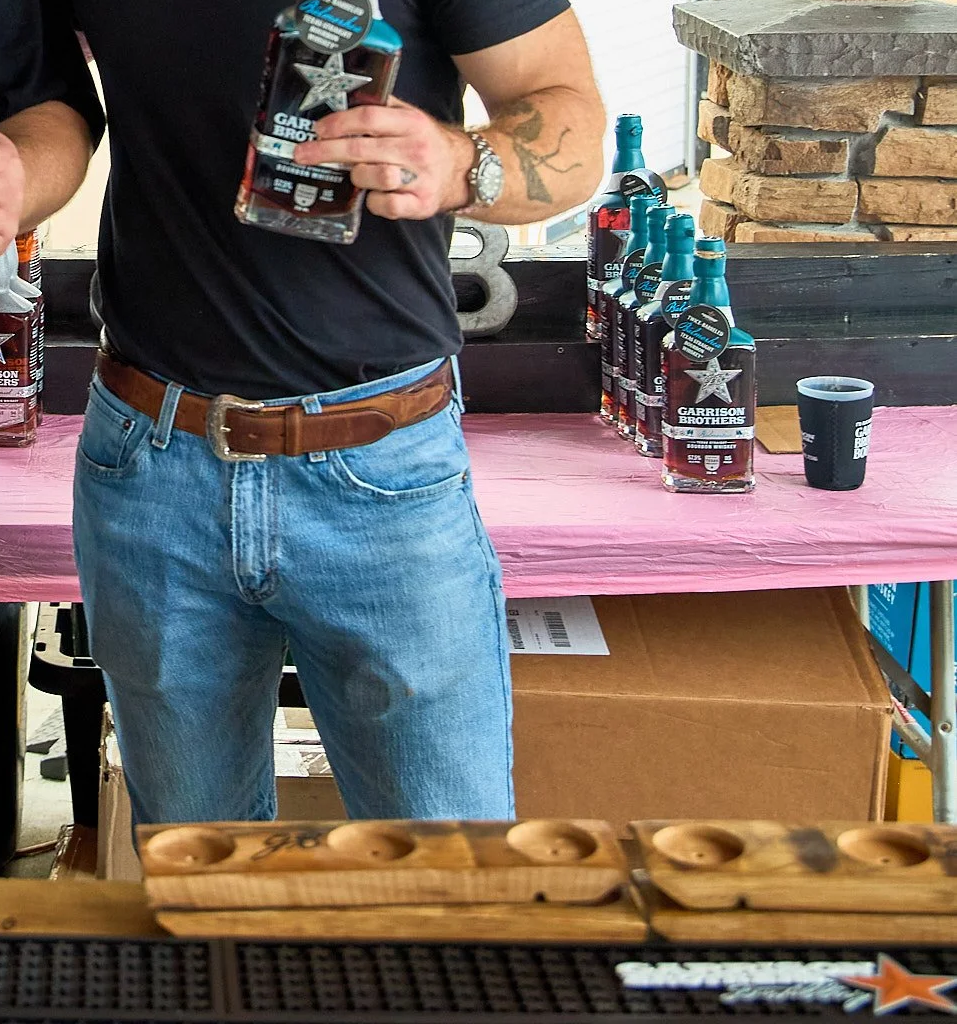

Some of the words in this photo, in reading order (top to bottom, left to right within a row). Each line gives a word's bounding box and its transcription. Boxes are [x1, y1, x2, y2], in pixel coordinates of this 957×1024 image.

[273, 112, 316, 130] GAR
[677, 406, 745, 416] GARRISON
[679, 416, 746, 425] BROTHERS
